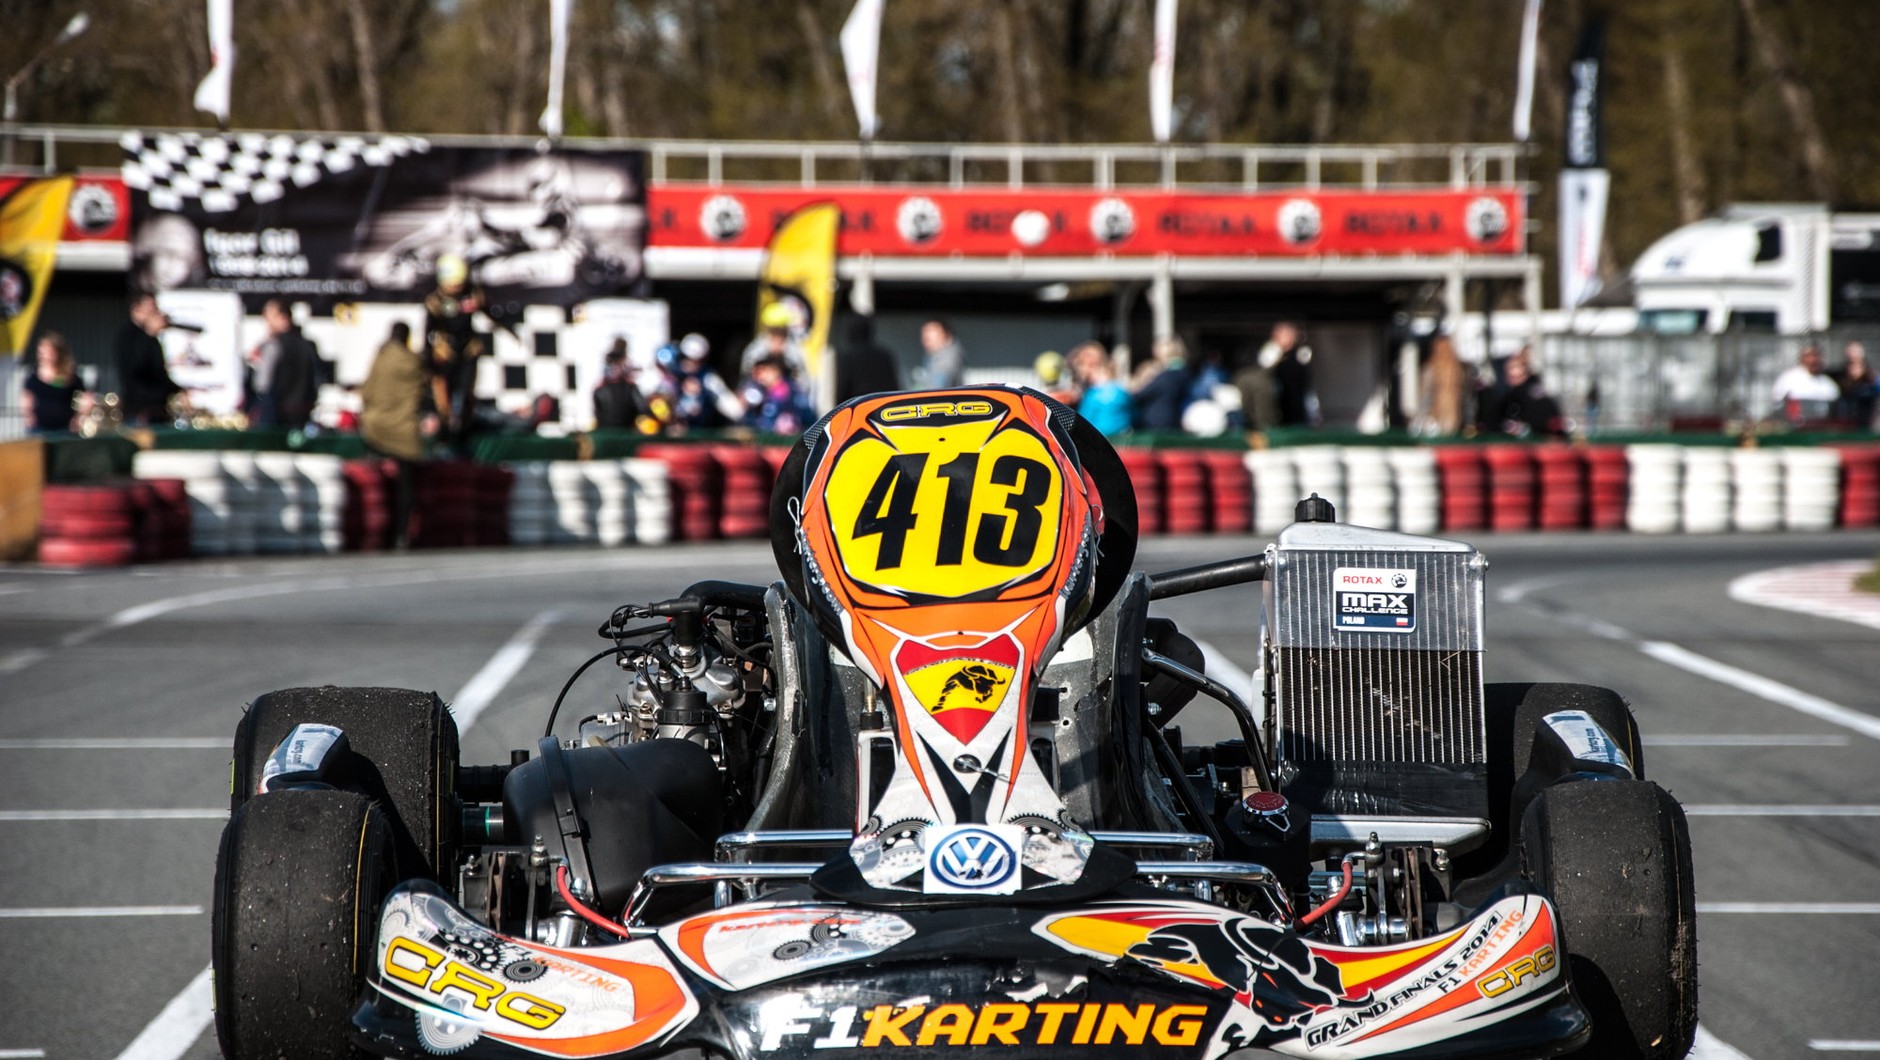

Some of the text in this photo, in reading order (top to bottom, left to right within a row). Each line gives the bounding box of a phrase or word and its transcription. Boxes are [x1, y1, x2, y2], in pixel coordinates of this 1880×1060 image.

[881, 401, 993, 421] CRG
[852, 452, 1052, 571] 413
[1343, 575, 1383, 584] ROTAX
[1342, 593, 1408, 609] MAX
[1342, 606, 1409, 615] CHALLENGE
[1342, 616, 1365, 625] POLAND
[1307, 913, 1499, 1047] GRAND FINALS 2014
[1475, 944, 1556, 998] CRG
[384, 936, 567, 1031] CRG
